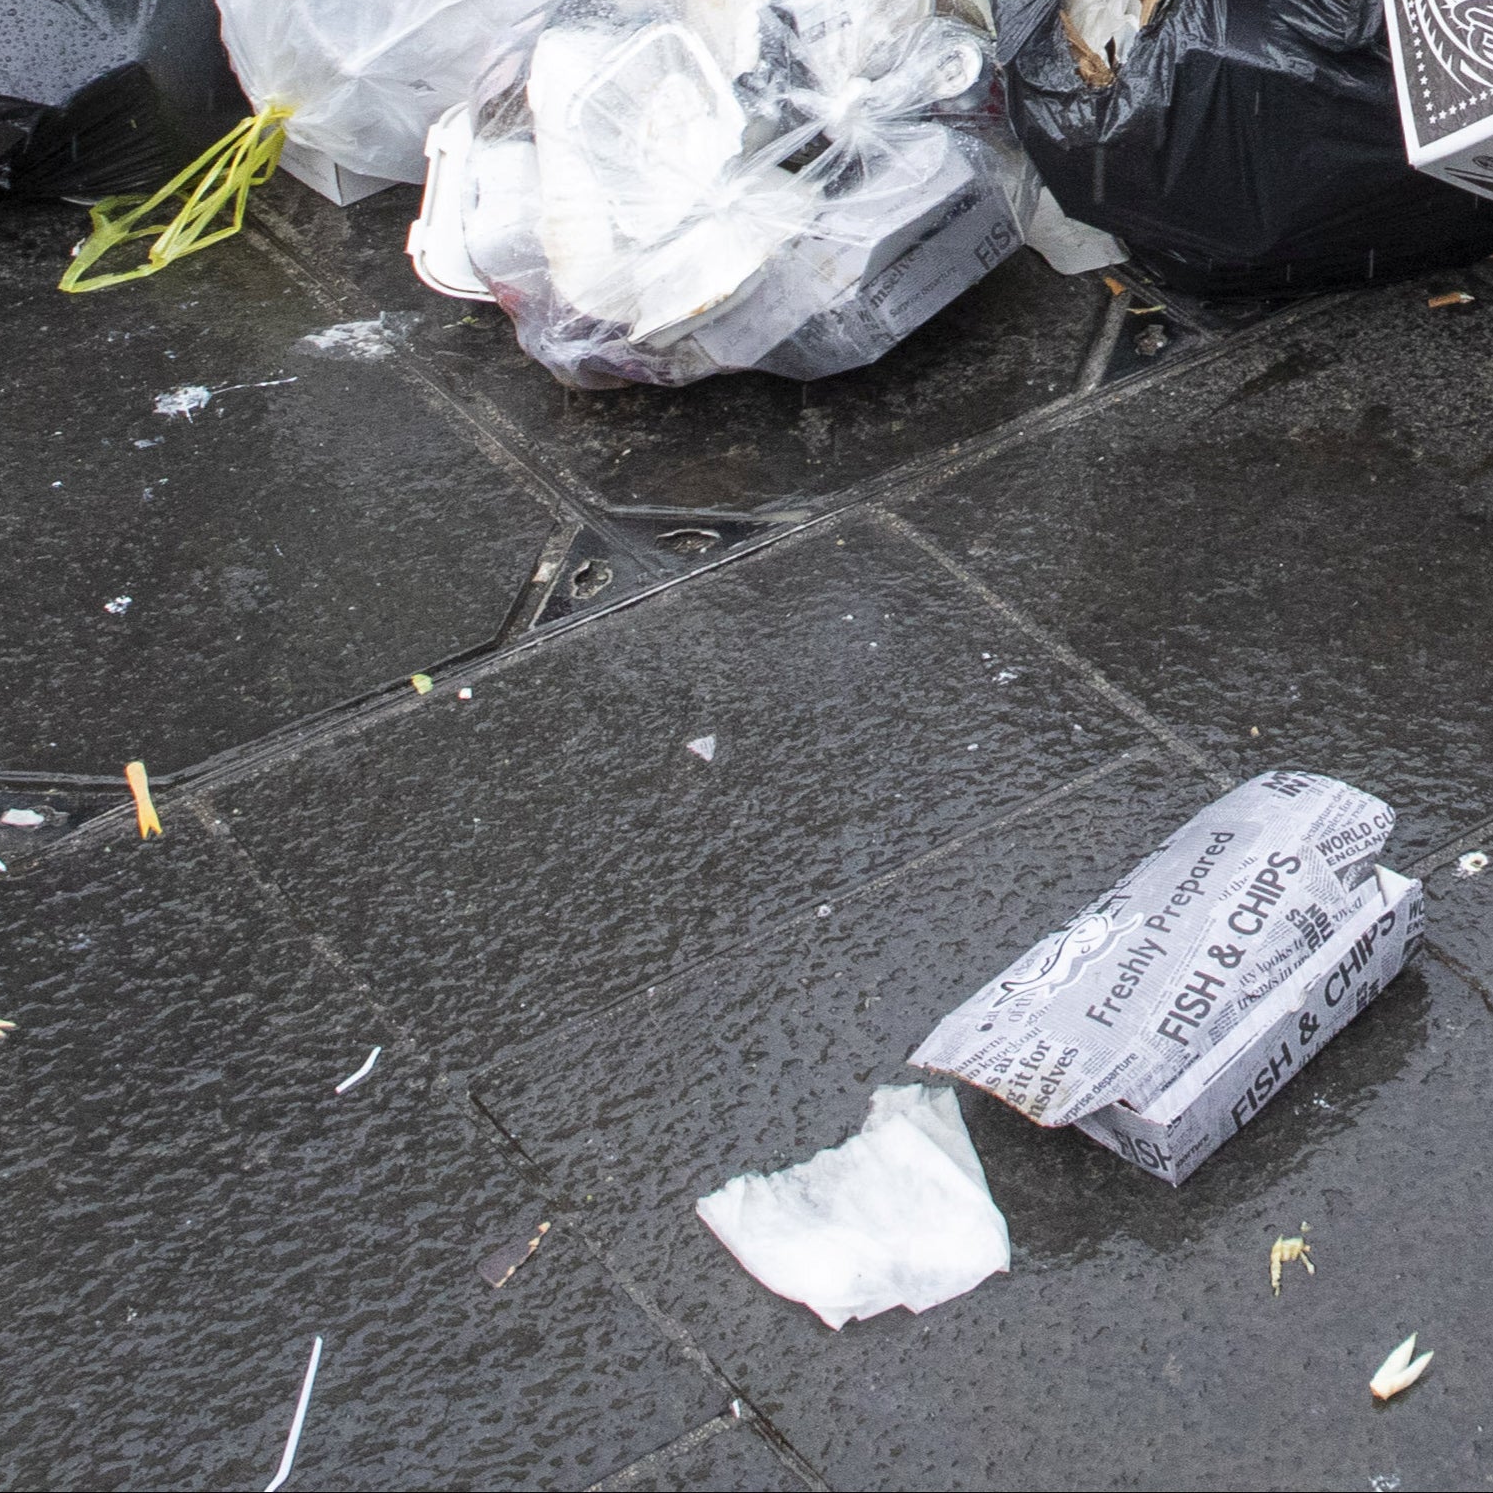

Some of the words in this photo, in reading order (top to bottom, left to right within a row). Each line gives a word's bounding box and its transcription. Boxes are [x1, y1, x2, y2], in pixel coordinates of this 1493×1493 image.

[1315, 821, 1374, 857] WORLD
[1325, 830, 1390, 867] ENGLAND
[1085, 937, 1169, 1028] Freshly
[1144, 831, 1235, 934] Prepared
[1157, 970, 1226, 1047] FISH
[1207, 943, 1247, 969] &
[1227, 851, 1301, 937] CHIPS
[1091, 1051, 1140, 1095] departure
[1230, 1041, 1294, 1131] FISH
[1298, 1010, 1321, 1046] &
[1324, 909, 1397, 1008] CHIPS
